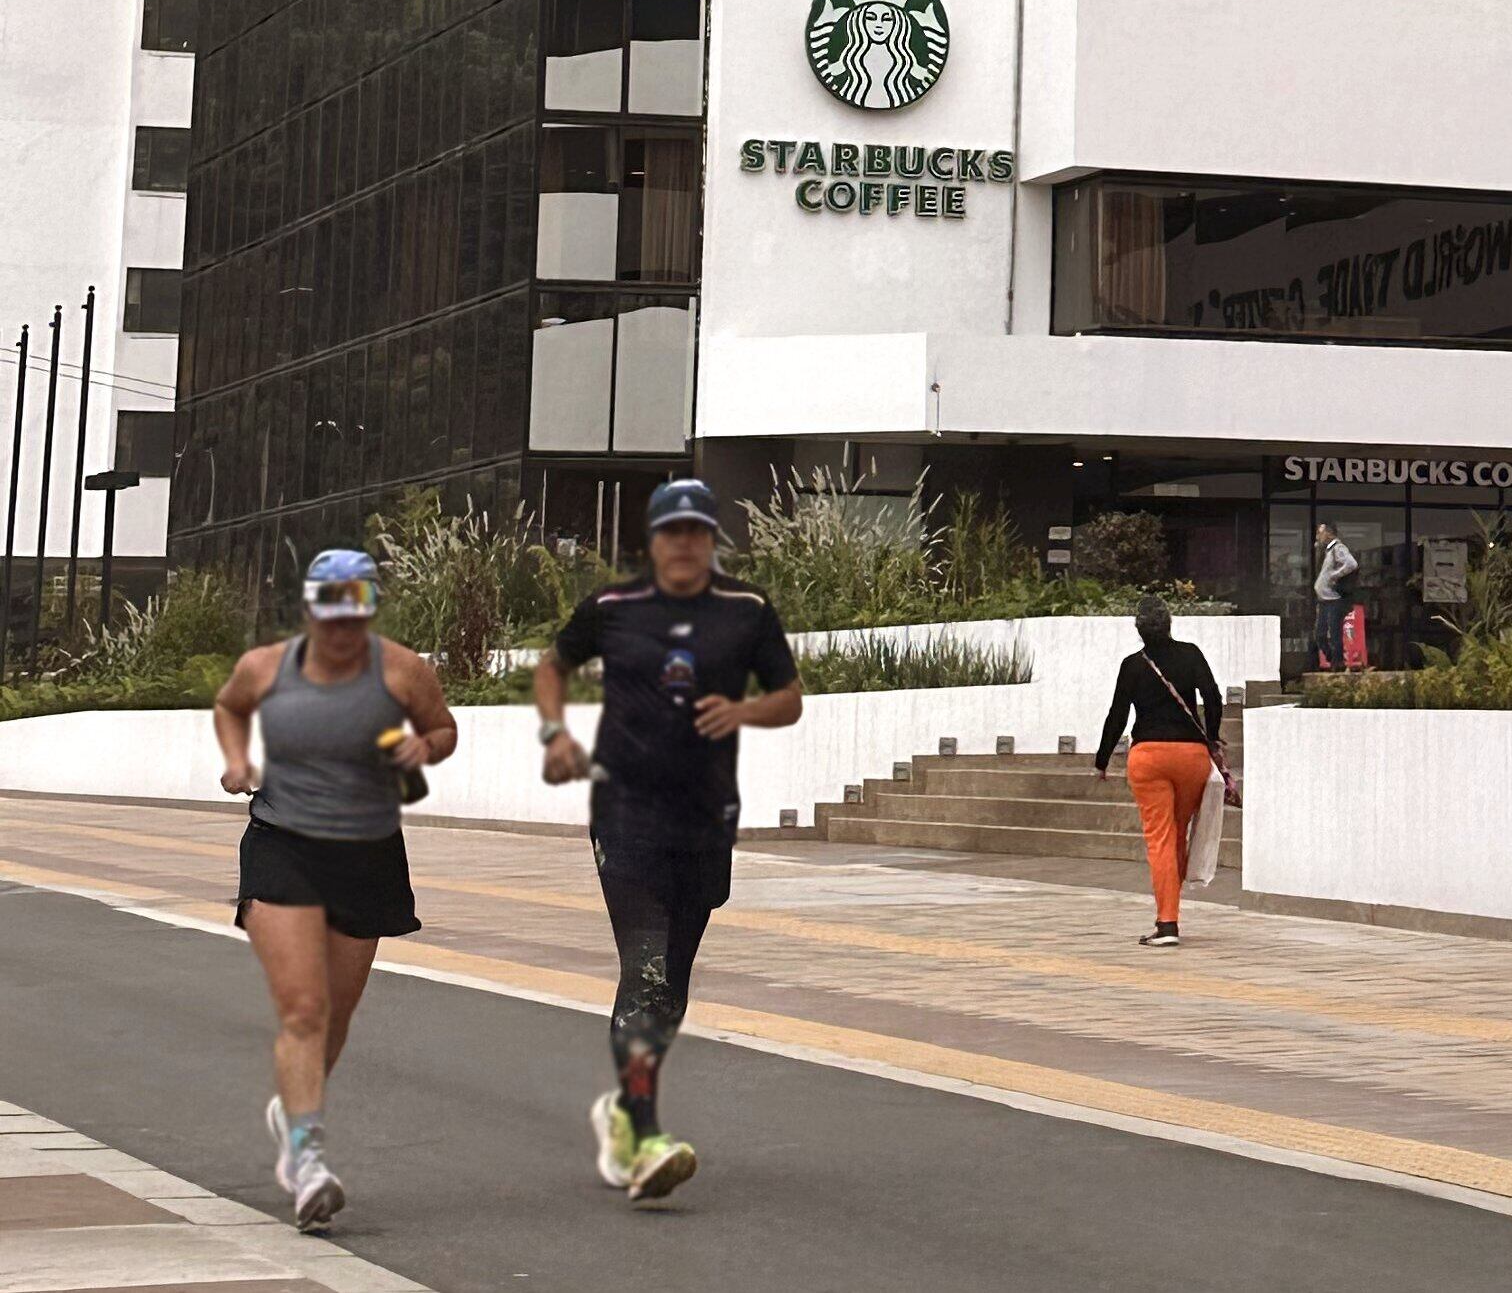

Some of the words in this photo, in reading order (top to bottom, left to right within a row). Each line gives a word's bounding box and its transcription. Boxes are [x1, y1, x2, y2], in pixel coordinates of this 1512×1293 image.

[740, 138, 1015, 183] STARBUCKS
[795, 179, 967, 219] COFFEE
[1284, 455, 1469, 486] STARBUCKS
